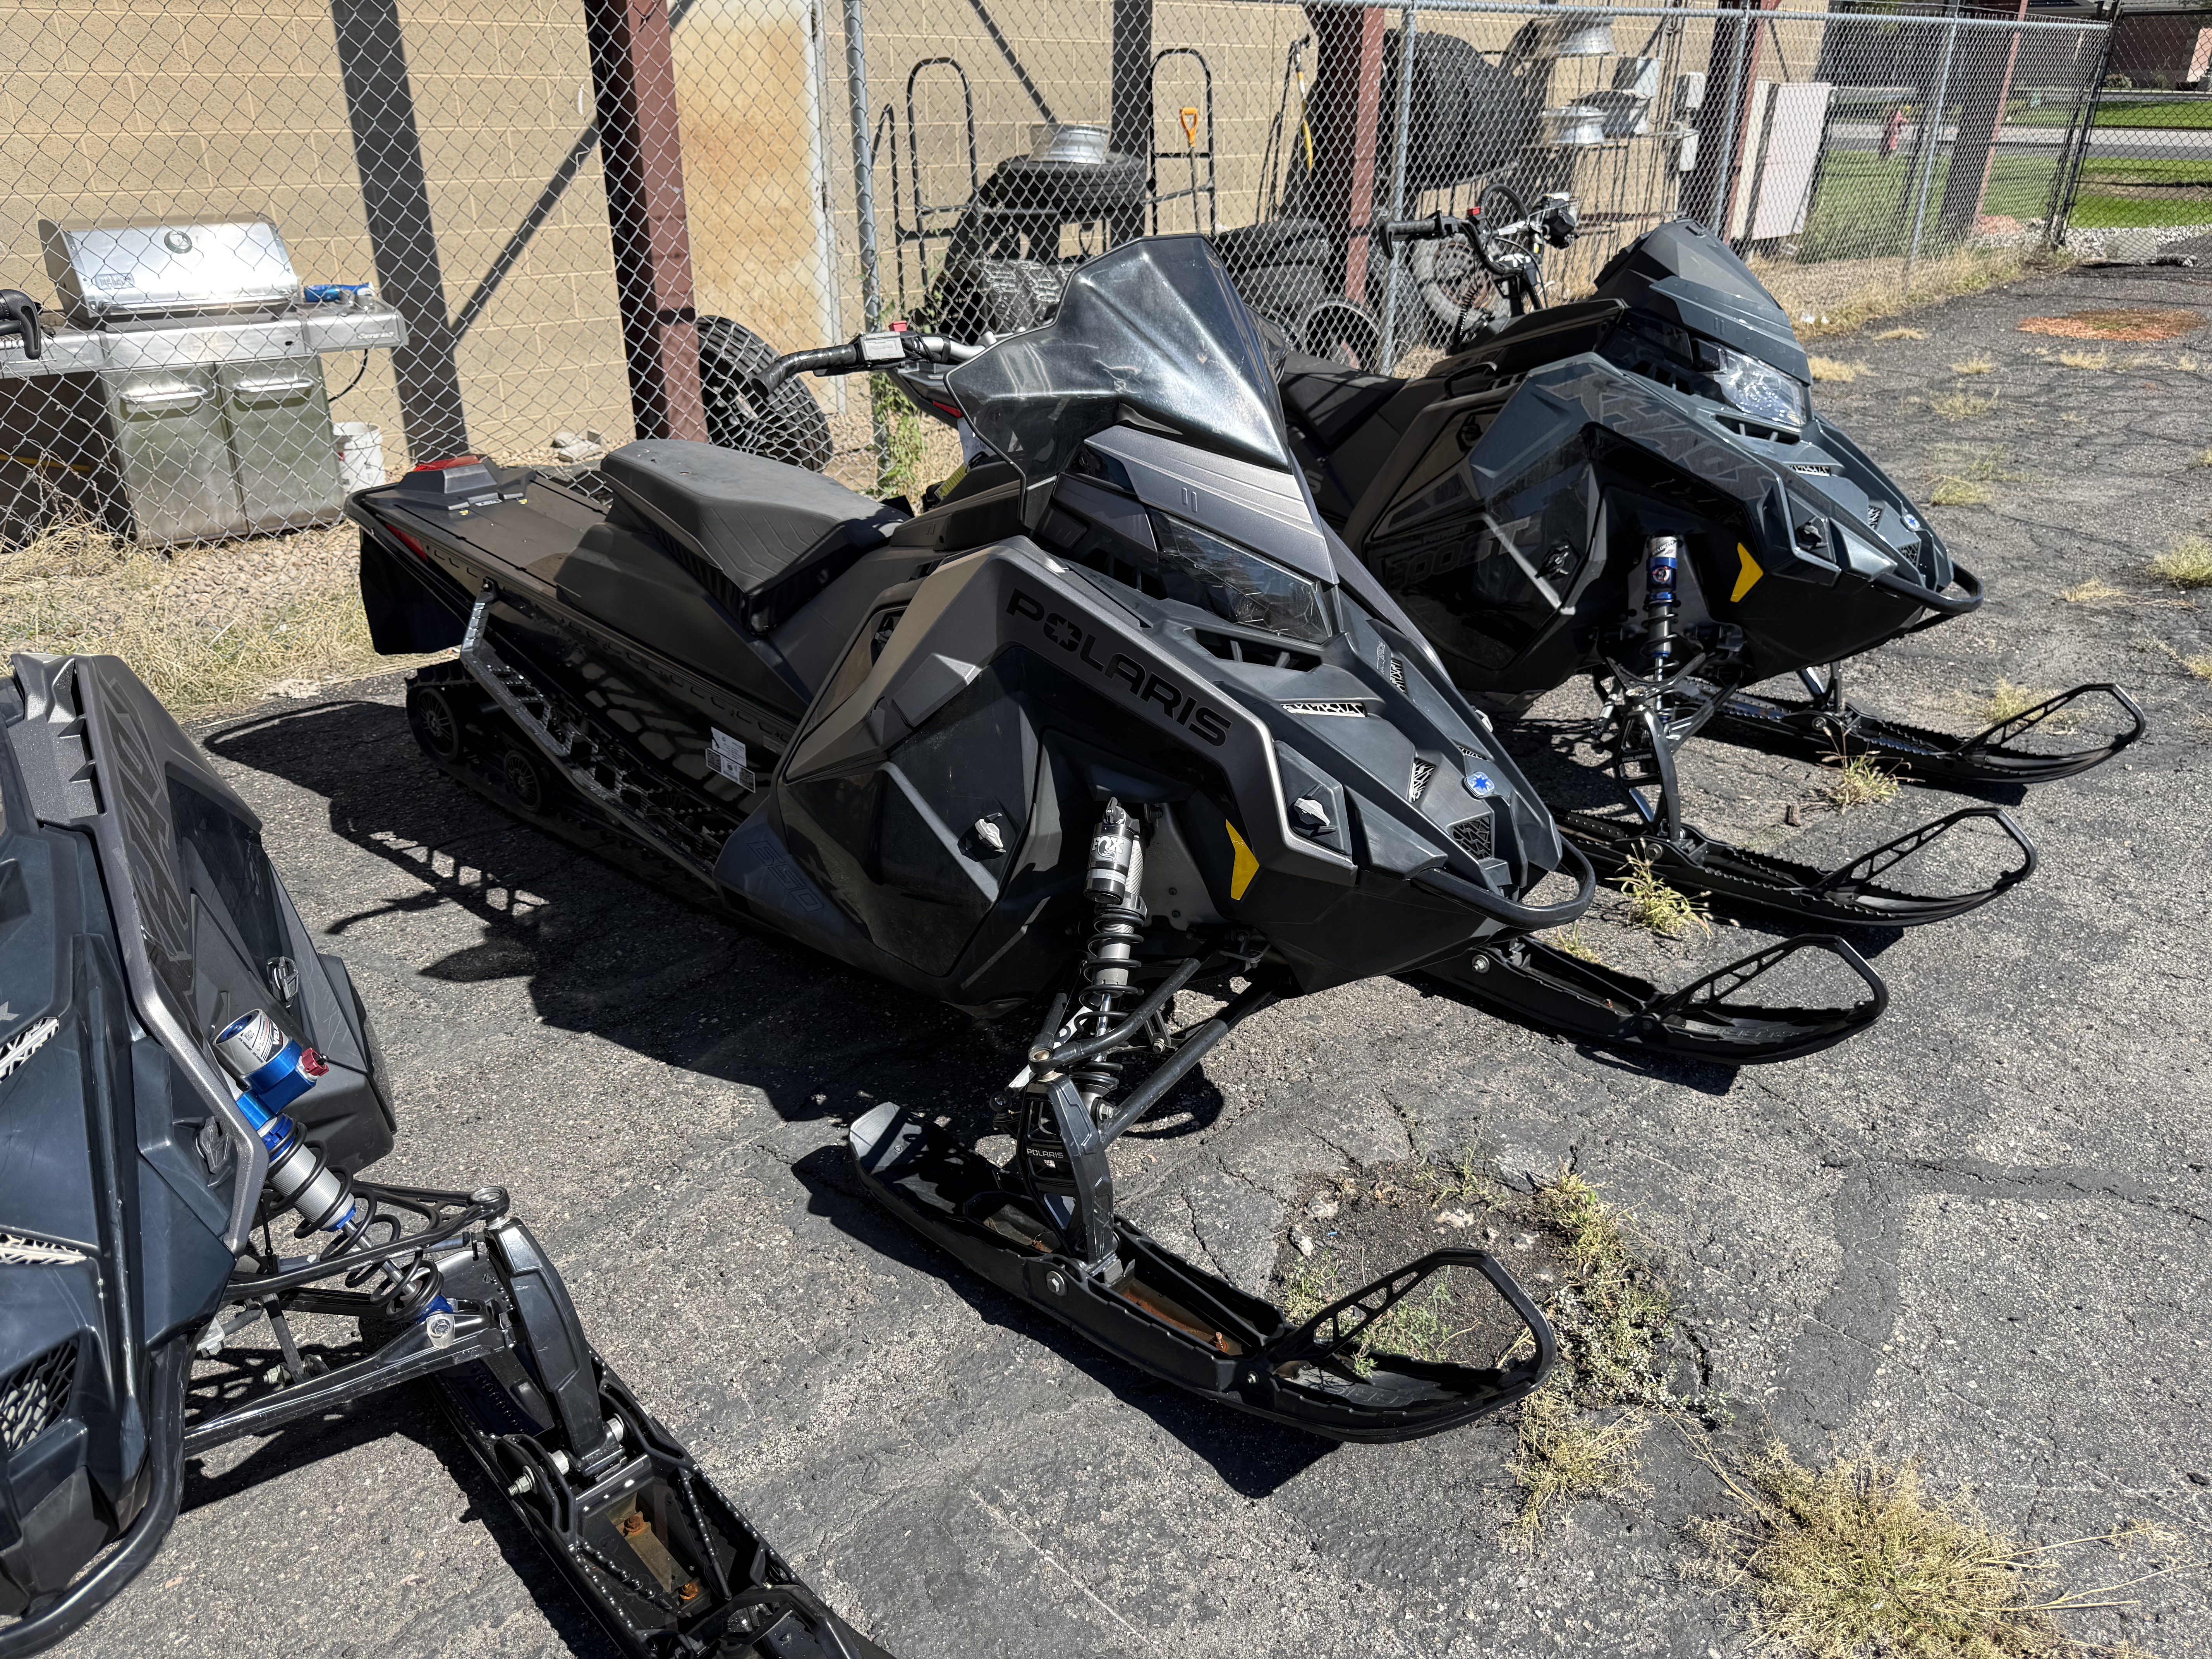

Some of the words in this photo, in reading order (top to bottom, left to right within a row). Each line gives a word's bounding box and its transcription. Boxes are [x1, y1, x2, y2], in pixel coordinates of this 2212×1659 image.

[1006, 587, 1233, 747] POLARIS
[1621, 753, 1652, 763] POLARIS
[1092, 835, 1124, 860] FOX
[747, 840, 824, 912] 850
[1026, 1148, 1064, 1158] POLARIS
[1321, 1386, 1414, 1407] LARIS
